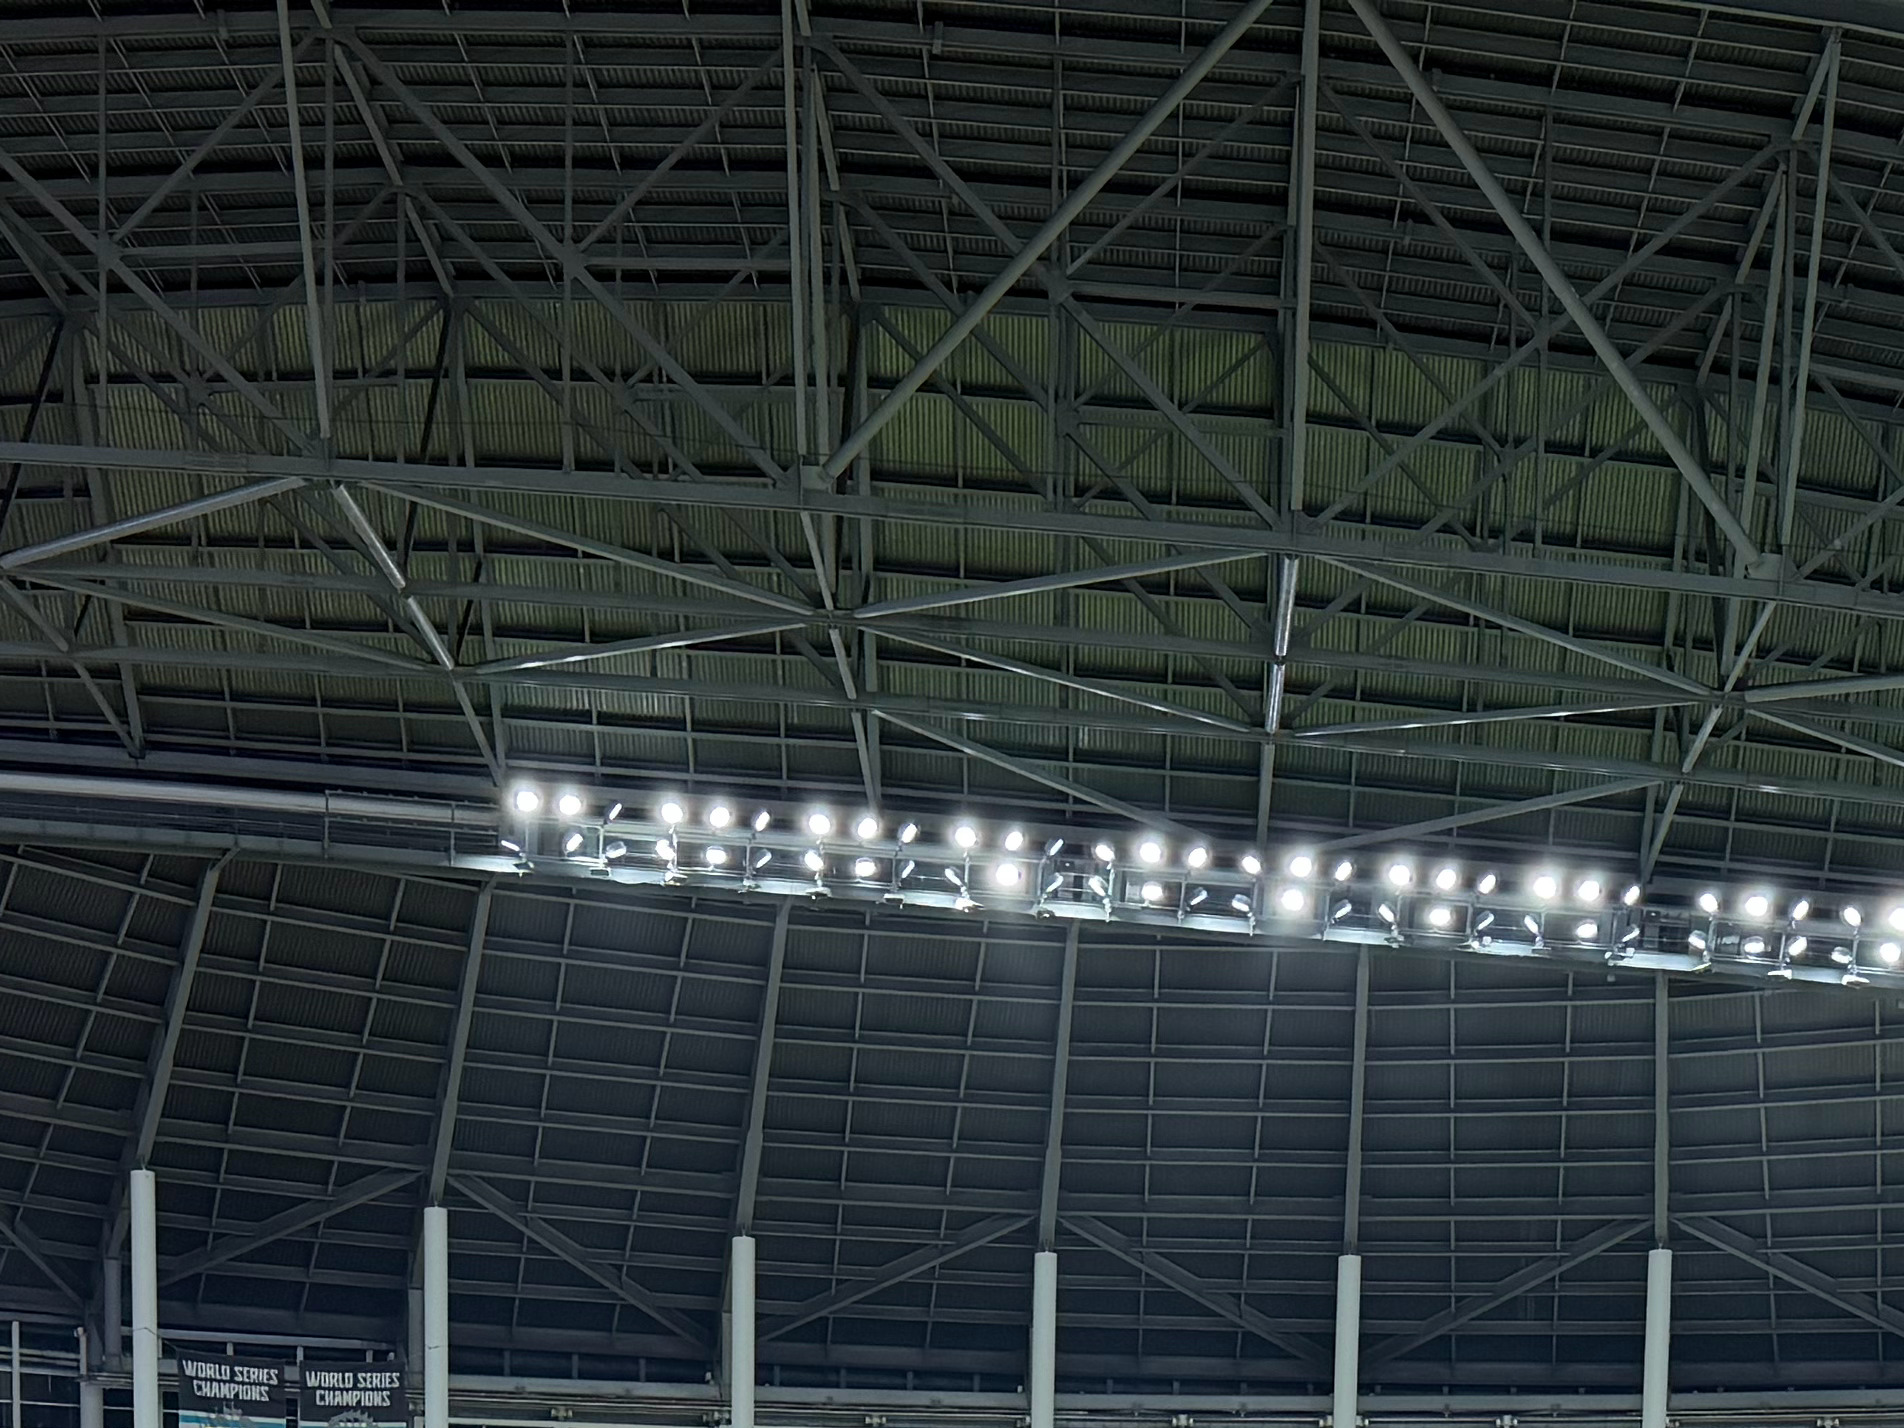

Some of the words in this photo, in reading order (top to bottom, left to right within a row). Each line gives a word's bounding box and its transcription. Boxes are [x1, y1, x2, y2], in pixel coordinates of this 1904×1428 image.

[182, 1360, 230, 1380] WORLD
[234, 1366, 279, 1385] SERIES
[306, 1371, 354, 1388] WORLD
[356, 1372, 400, 1388] SERIES
[193, 1380, 270, 1401] CHAMPIONS
[316, 1391, 391, 1407] CHAMPIONS
